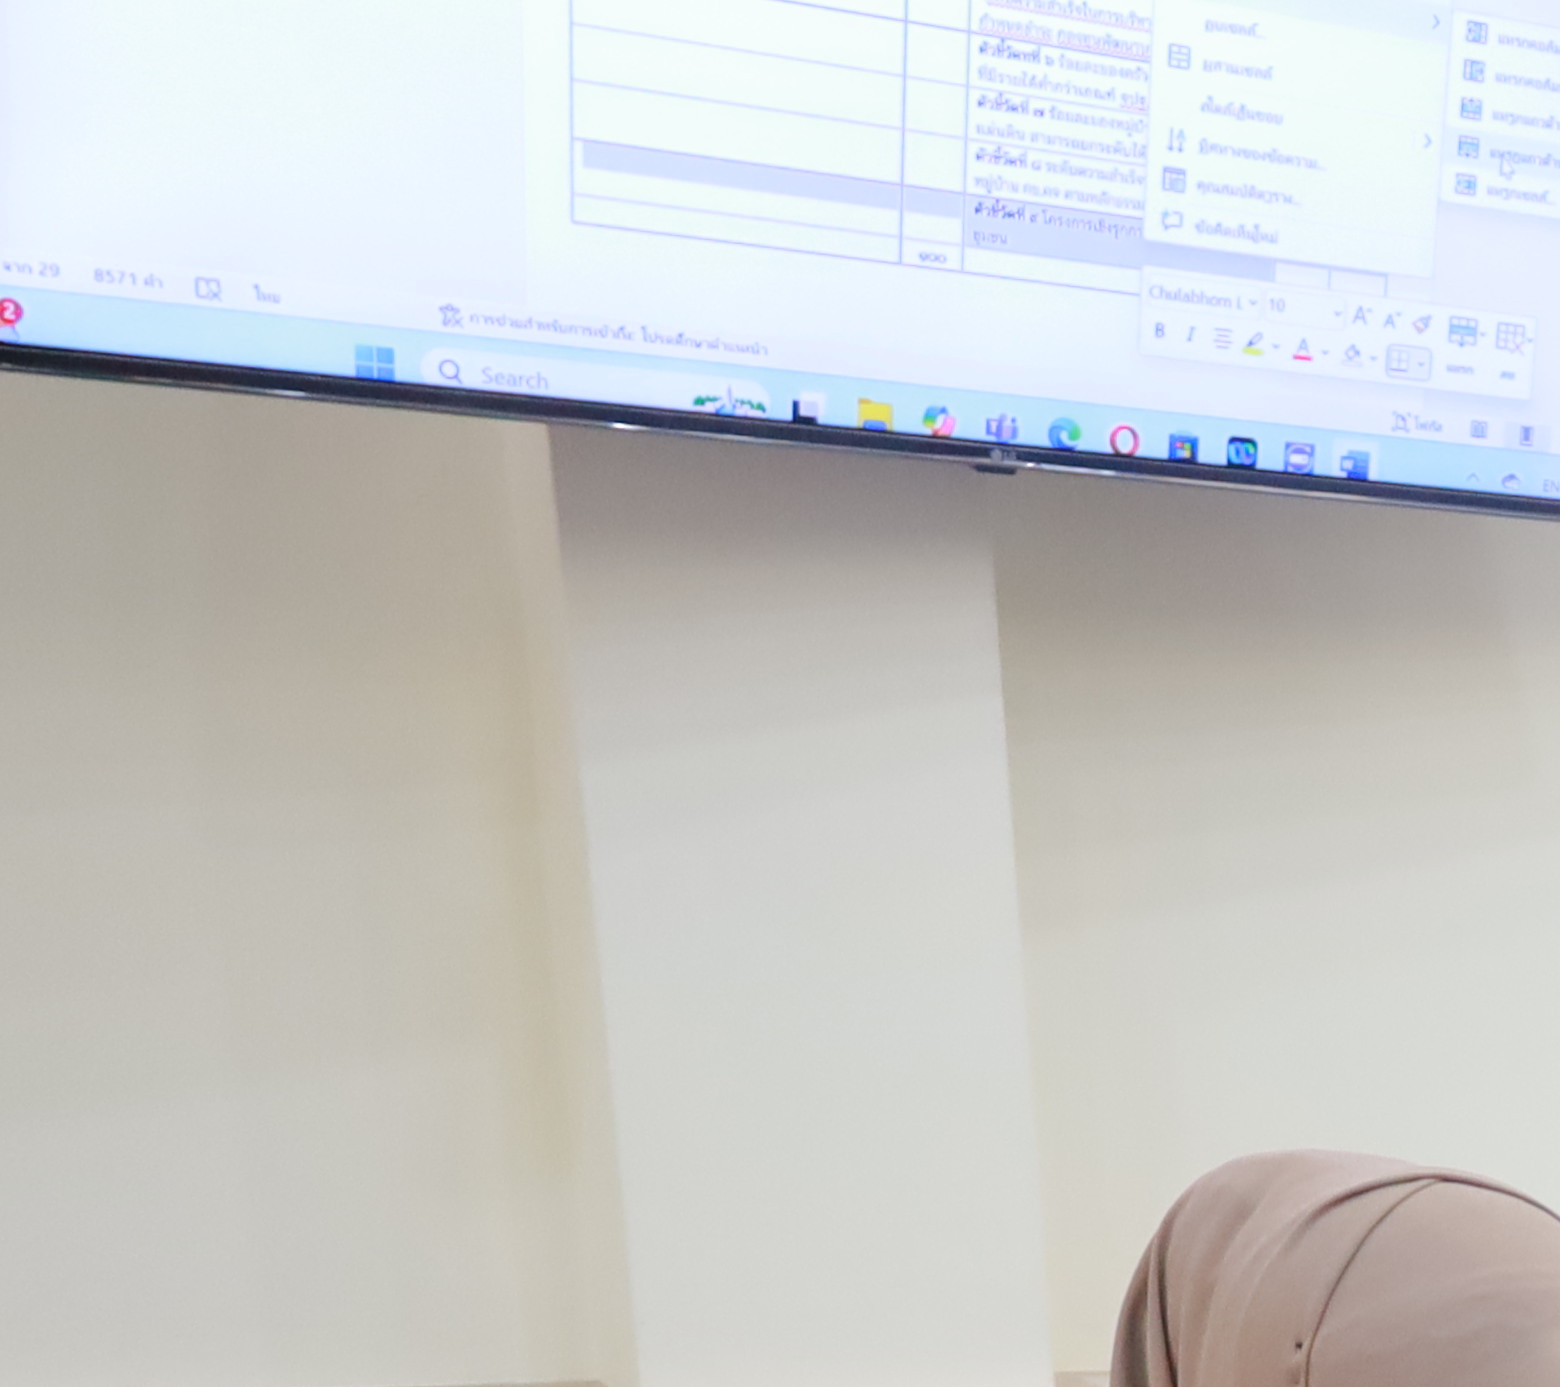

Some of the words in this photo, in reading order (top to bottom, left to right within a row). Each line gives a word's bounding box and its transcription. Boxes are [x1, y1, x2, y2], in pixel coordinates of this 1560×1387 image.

[38, 262, 61, 278] 29
[93, 267, 138, 287] 8571
[1149, 284, 1233, 308] Chulabhorn
[1269, 297, 1286, 313] 10
[3, 301, 16, 321] 2
[481, 365, 549, 391] Search
